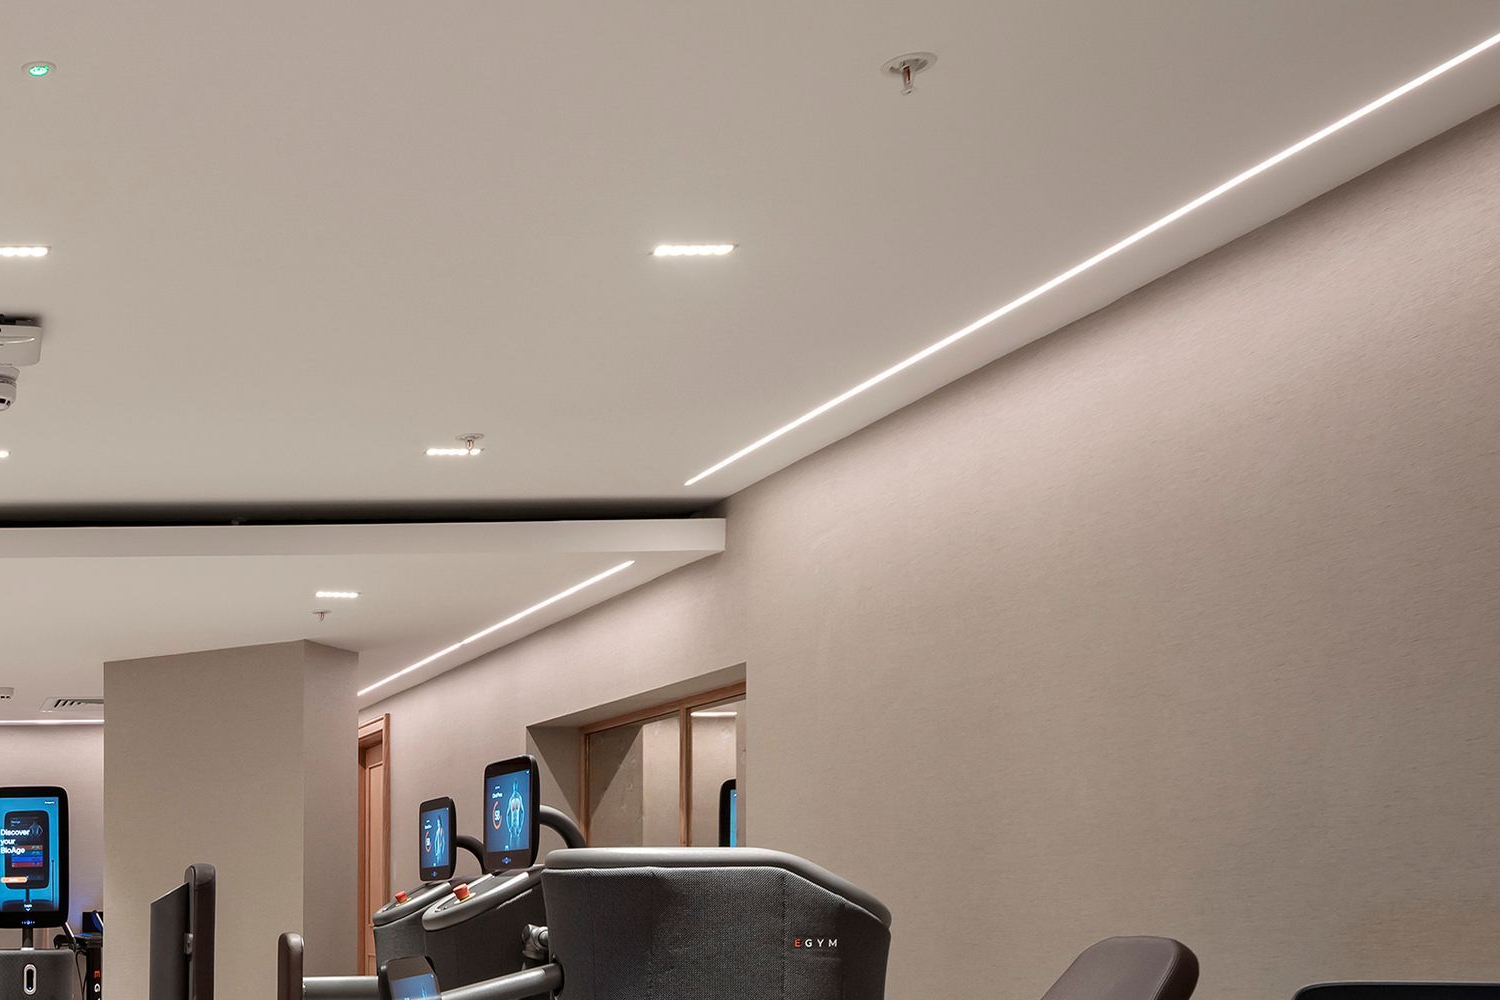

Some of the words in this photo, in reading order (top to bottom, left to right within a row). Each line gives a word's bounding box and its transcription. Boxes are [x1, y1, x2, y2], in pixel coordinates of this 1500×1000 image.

[0, 828, 30, 836] Discover
[0, 847, 26, 855] BioAge
[794, 939, 838, 948] EGYM
